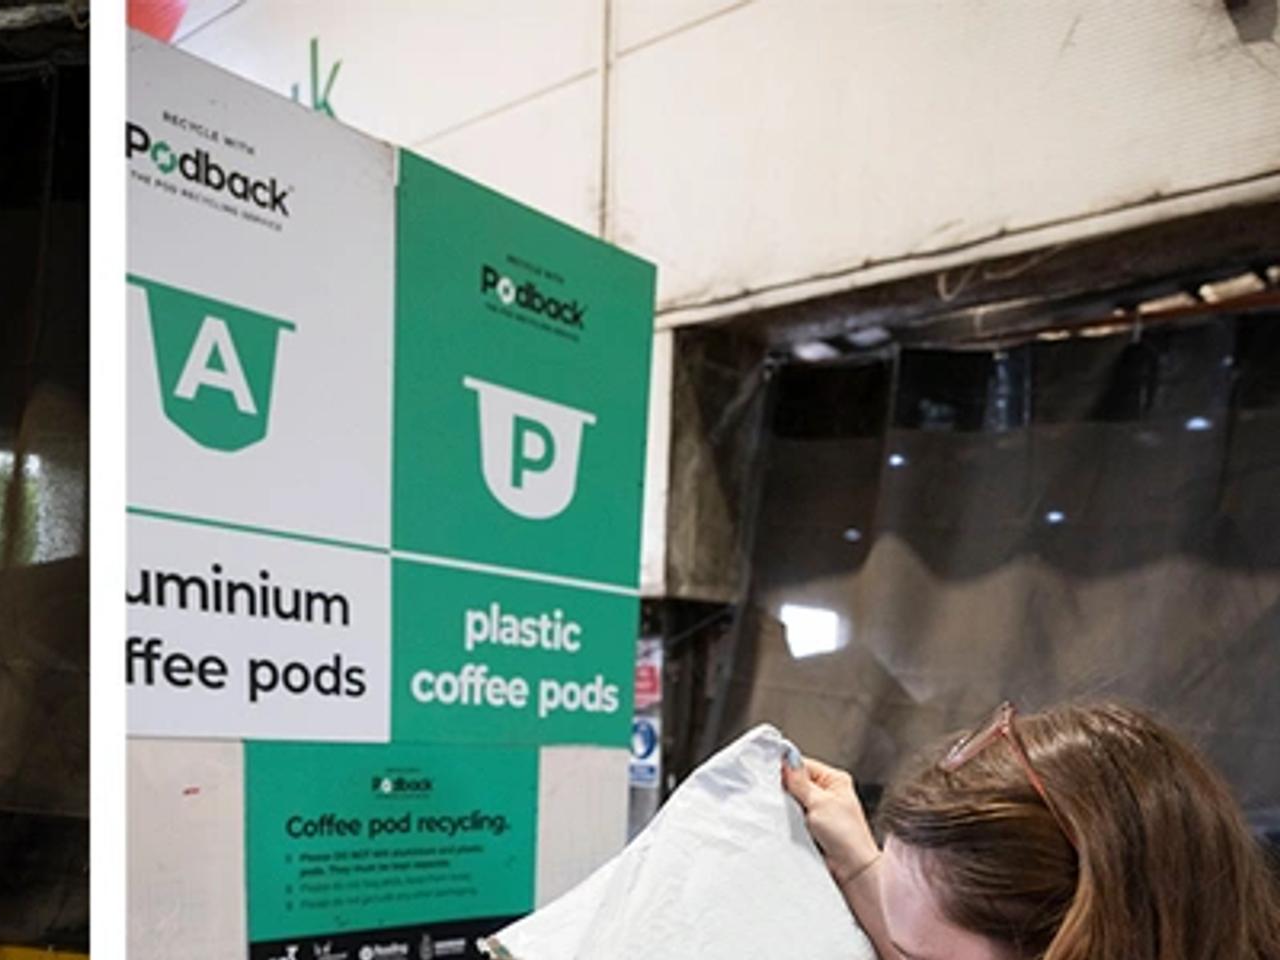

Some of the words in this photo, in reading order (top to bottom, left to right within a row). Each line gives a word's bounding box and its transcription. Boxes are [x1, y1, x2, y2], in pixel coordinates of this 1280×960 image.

[162, 110, 219, 143] RECYCLE
[224, 136, 256, 156] WITH
[125, 121, 289, 218] Podback
[480, 262, 585, 332] Podback
[173, 314, 259, 415] A
[510, 412, 557, 491] P
[126, 562, 351, 627] uminium
[464, 601, 582, 652] plastic
[126, 636, 229, 691] ffee
[248, 653, 368, 703] pods
[410, 663, 530, 708] coffee
[536, 673, 620, 719] pods
[285, 813, 363, 839] Coffee
[367, 811, 412, 840] pod
[416, 808, 511, 838] recycling.
